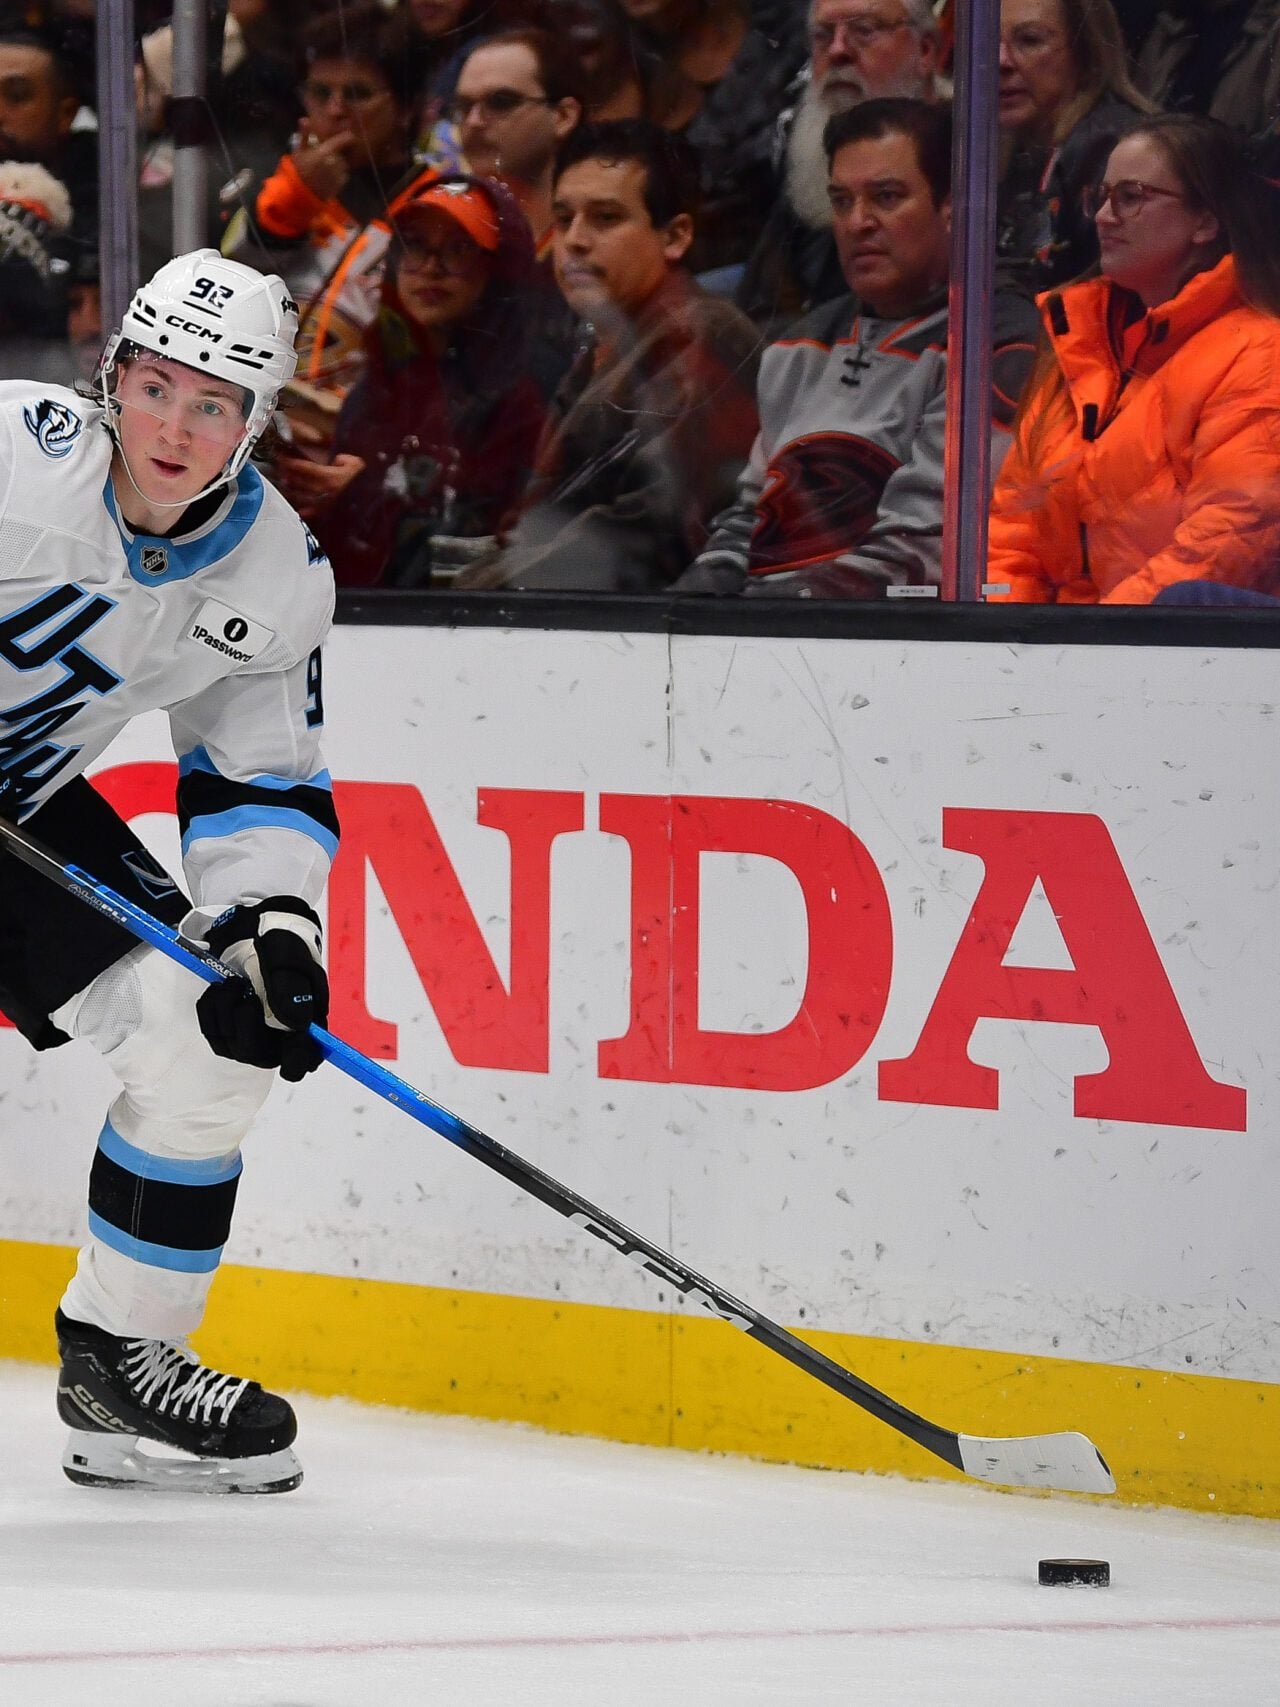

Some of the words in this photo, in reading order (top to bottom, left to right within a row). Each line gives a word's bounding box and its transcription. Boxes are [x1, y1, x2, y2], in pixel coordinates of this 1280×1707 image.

[188, 277, 234, 309] 92
[165, 314, 223, 343] CCM
[192, 625, 255, 663] 1Password
[205, 957, 236, 978] COOLEY
[568, 1212, 754, 1332] CCM
[74, 1384, 138, 1433] CCM
